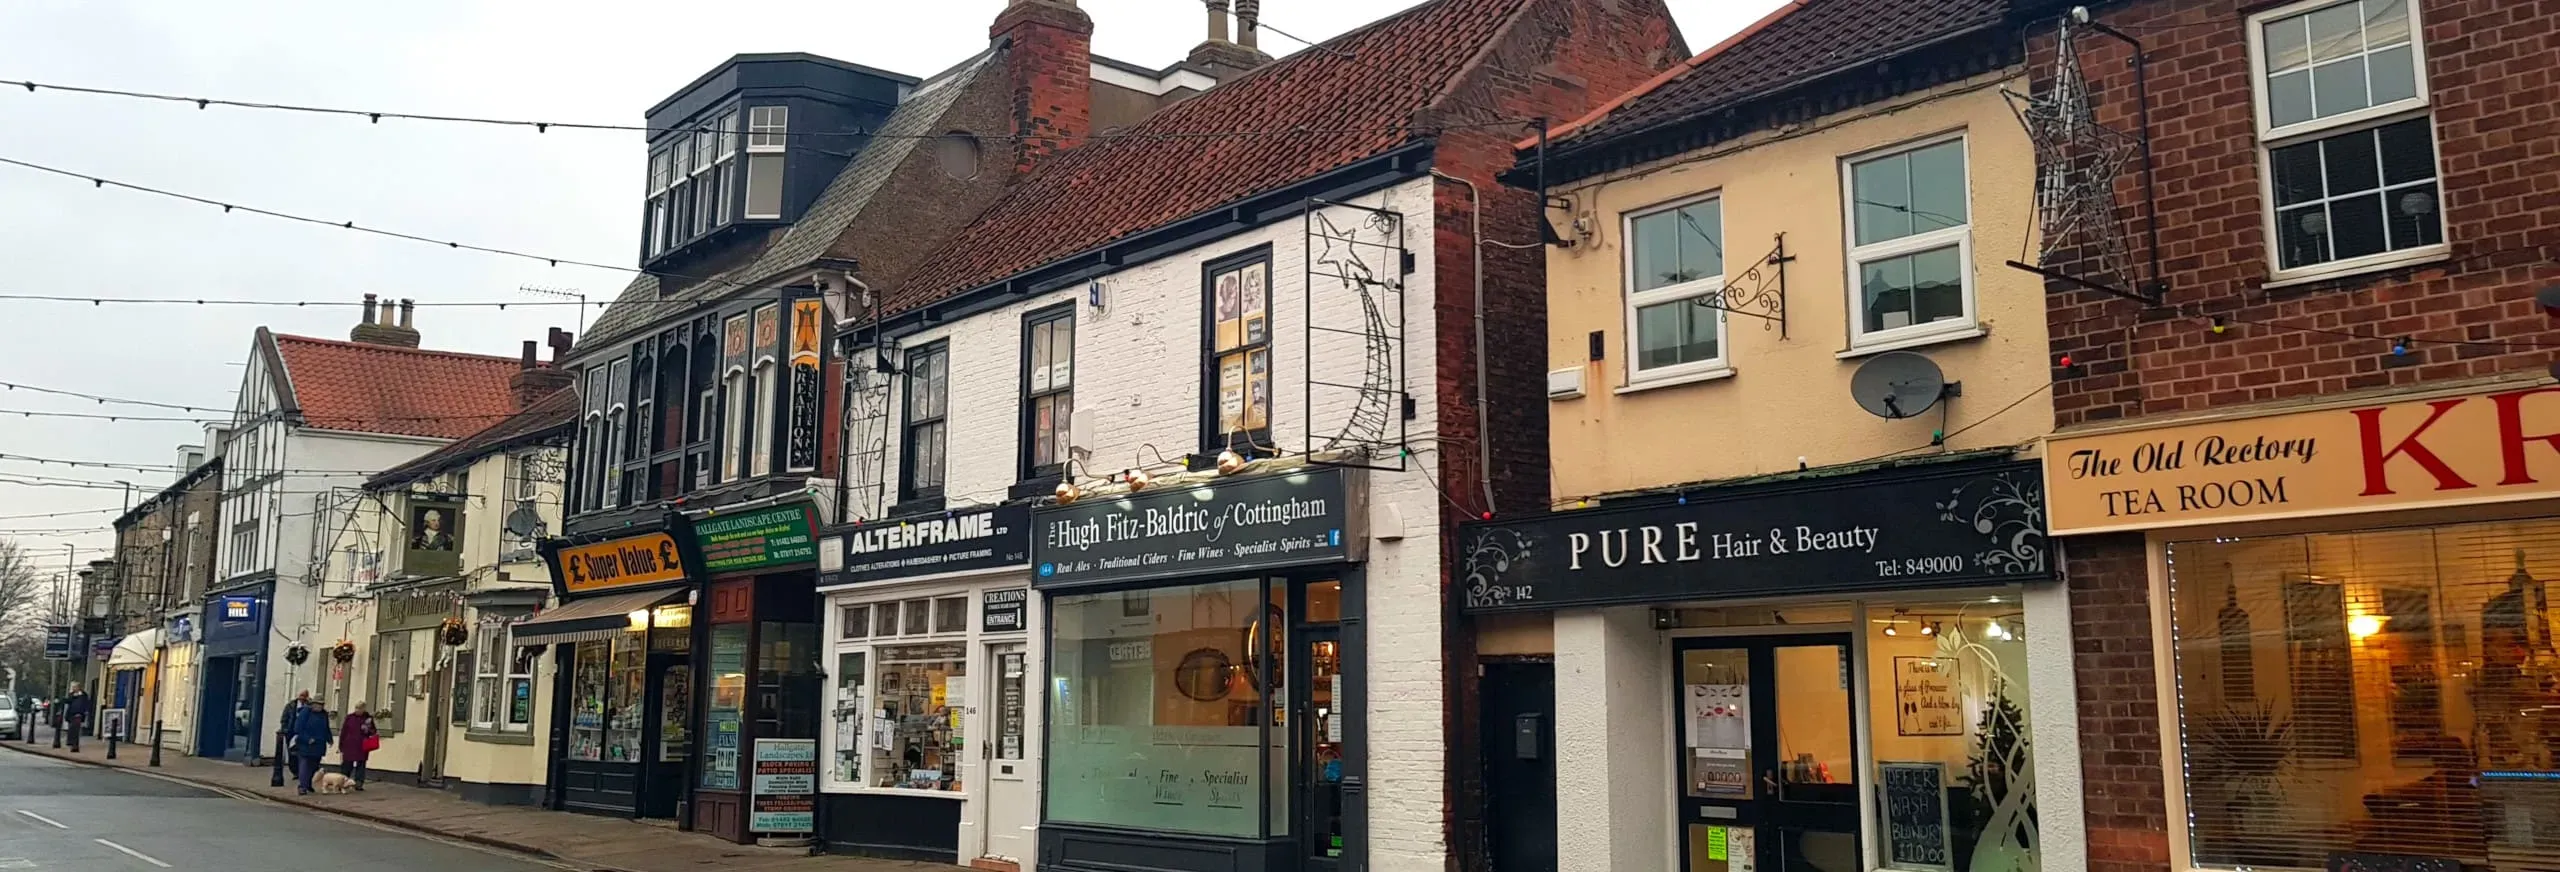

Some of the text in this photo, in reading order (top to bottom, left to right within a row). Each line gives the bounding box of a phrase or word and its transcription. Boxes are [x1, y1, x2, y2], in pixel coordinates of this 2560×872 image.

[793, 364, 806, 462] CREATIONS
[2067, 434, 2317, 480] The Old Rectory
[2100, 477, 2289, 517] TEA ROOM
[695, 520, 732, 536] HALLGATE
[732, 514, 773, 530] LANDSCAPE
[772, 509, 802, 523] CENTRE
[851, 512, 1008, 555] ALTERFRAME LTD
[1048, 497, 1326, 551] The Hugh Fitz-Baldric of Cottingham
[1056, 562, 1072, 574] Real
[1075, 561, 1091, 572] Ales
[1099, 554, 1141, 570] Traditional
[1143, 552, 1168, 565] Ciders
[1178, 549, 1195, 561] Fine
[1198, 547, 1224, 559] Wines
[1234, 541, 1277, 557] Specialist
[1280, 537, 1311, 553] Spirits
[1568, 521, 1879, 571] PURE Hair & Beauty
[584, 552, 620, 582] Super
[618, 545, 657, 576] Value
[871, 560, 900, 570] ALTERATIONS
[948, 552, 969, 561] PICTURE
[970, 548, 993, 558] FRAMING
[1876, 555, 1963, 577] Tel: 849000
[984, 591, 1026, 604] CREATIONS
[1516, 585, 1533, 600] 142
[228, 607, 249, 617] HILL
[986, 613, 1016, 625] ENTRANCE
[965, 707, 977, 715] 146
[759, 751, 804, 761] Landscapes
[774, 743, 806, 752] Hallgate
[1158, 769, 1248, 786] Fine Specialist
[1886, 768, 1938, 788] OFFER
[1889, 796, 1929, 817] WASH
